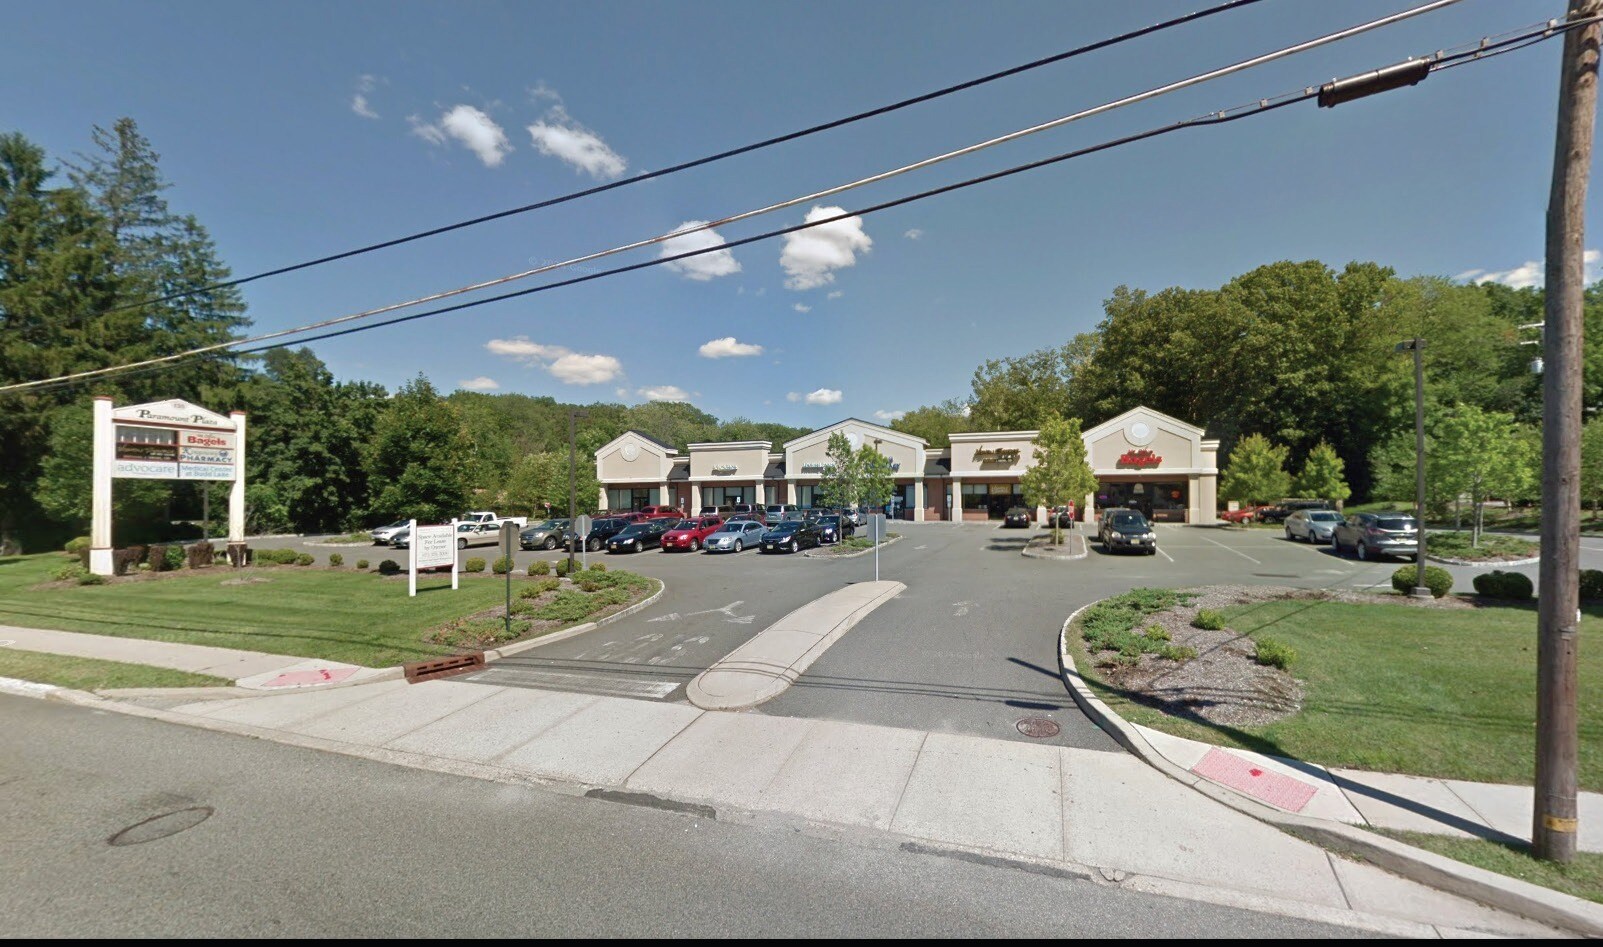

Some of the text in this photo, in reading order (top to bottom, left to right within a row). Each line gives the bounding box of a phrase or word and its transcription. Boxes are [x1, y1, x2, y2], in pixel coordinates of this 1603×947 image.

[136, 409, 218, 425] Paramount Plaza
[187, 435, 227, 446] Bagels
[180, 454, 232, 463] PHARMACY
[117, 463, 175, 473] advocare
